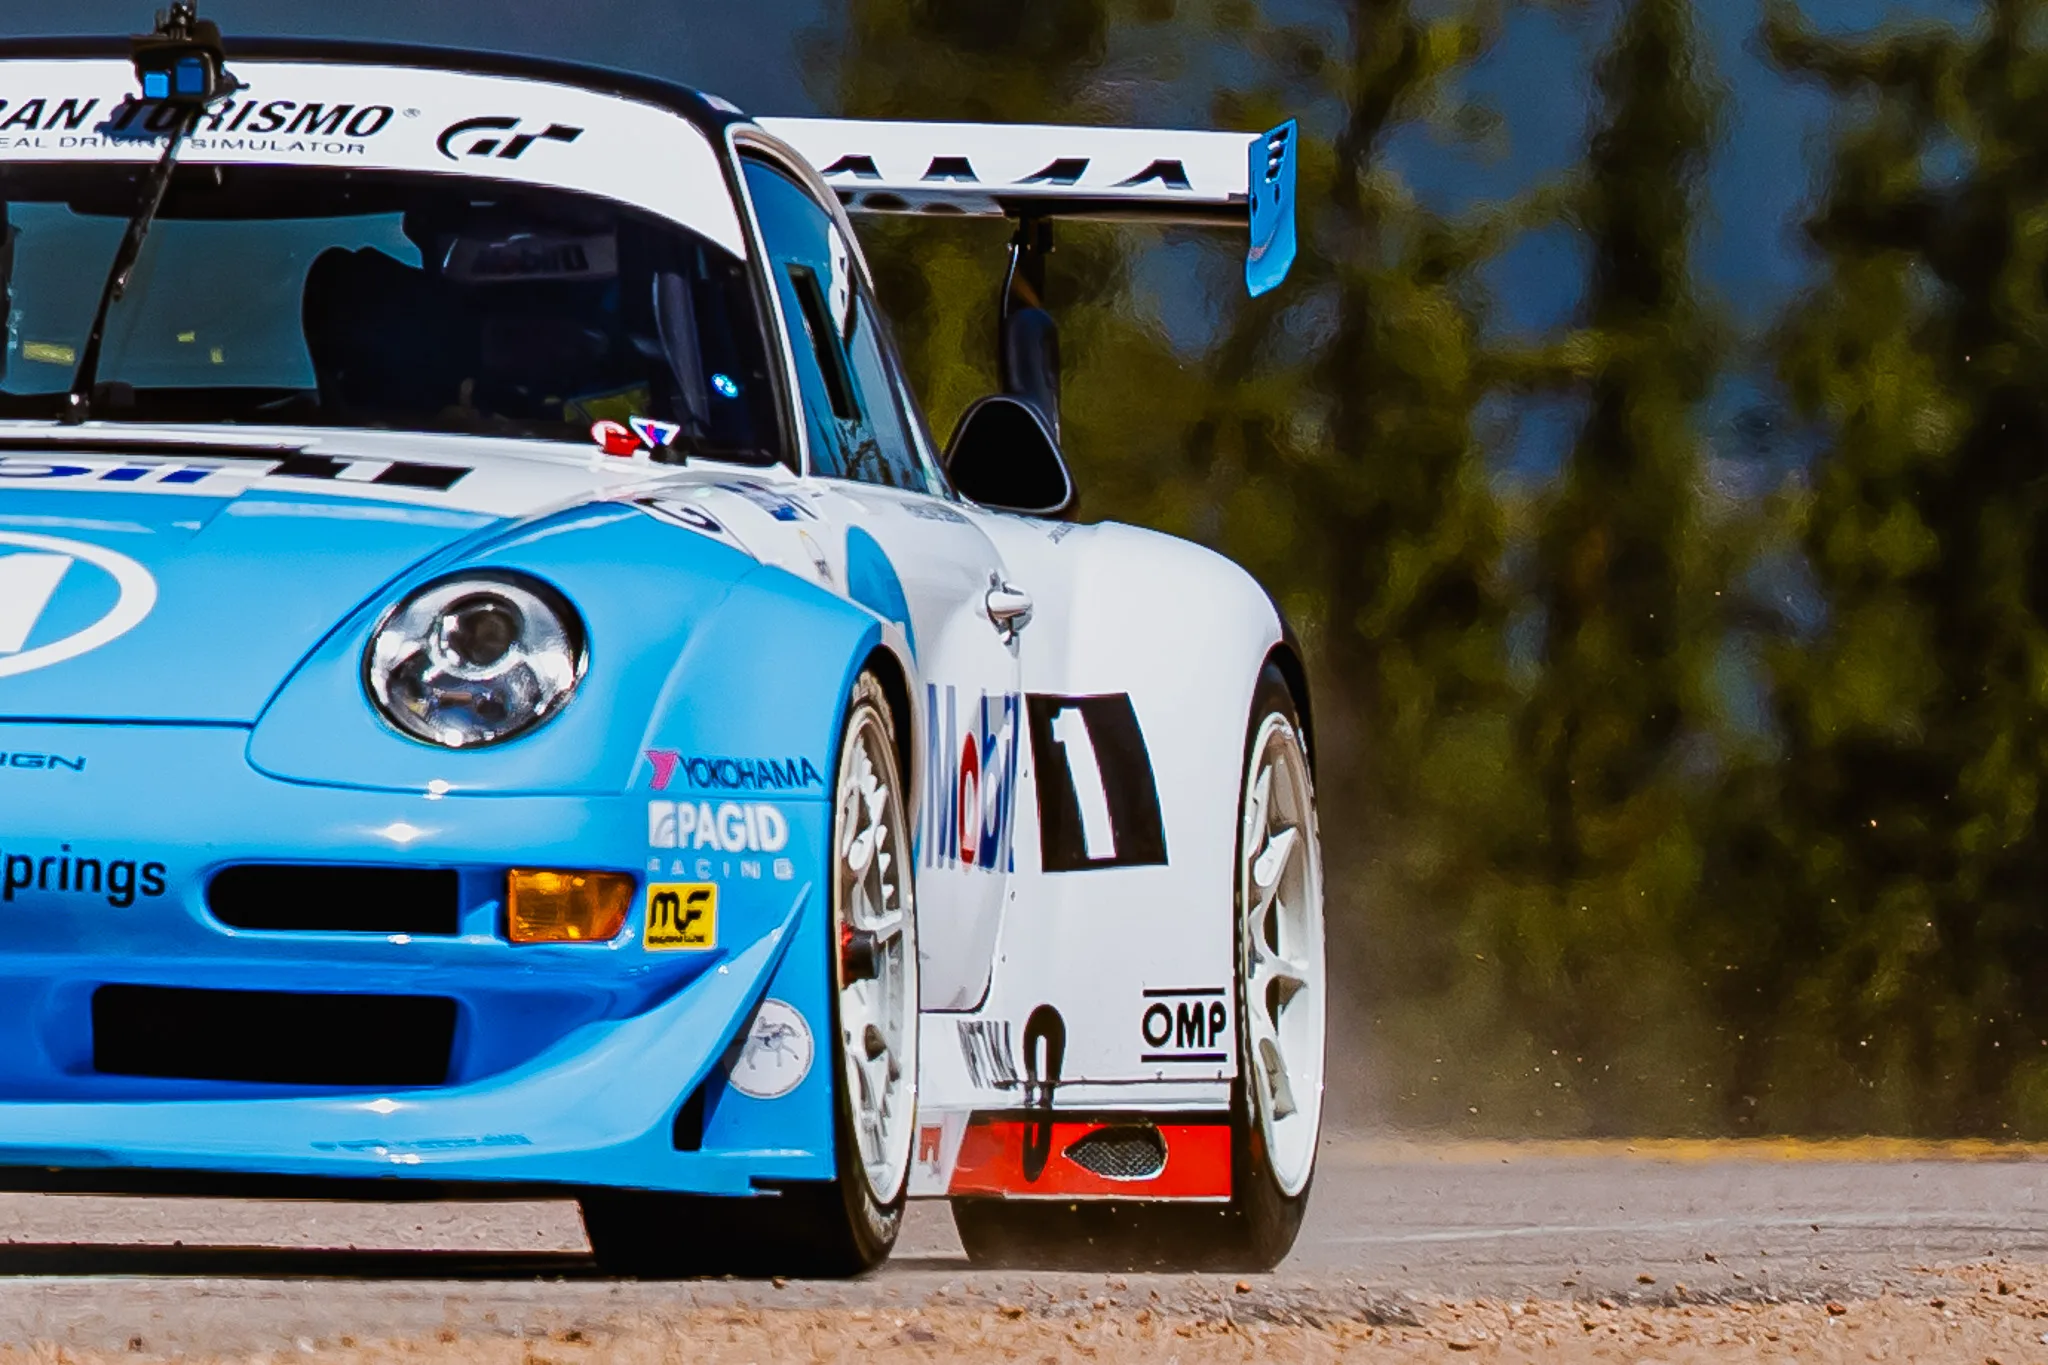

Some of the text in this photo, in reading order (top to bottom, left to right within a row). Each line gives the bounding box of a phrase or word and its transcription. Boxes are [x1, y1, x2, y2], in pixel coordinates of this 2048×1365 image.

[190, 138, 366, 155] SIMULATOR
[678, 756, 825, 790] YOKOHAMA
[1051, 707, 1117, 860] 1
[676, 801, 789, 853] PAGID
[1142, 1001, 1227, 1049] OMP
